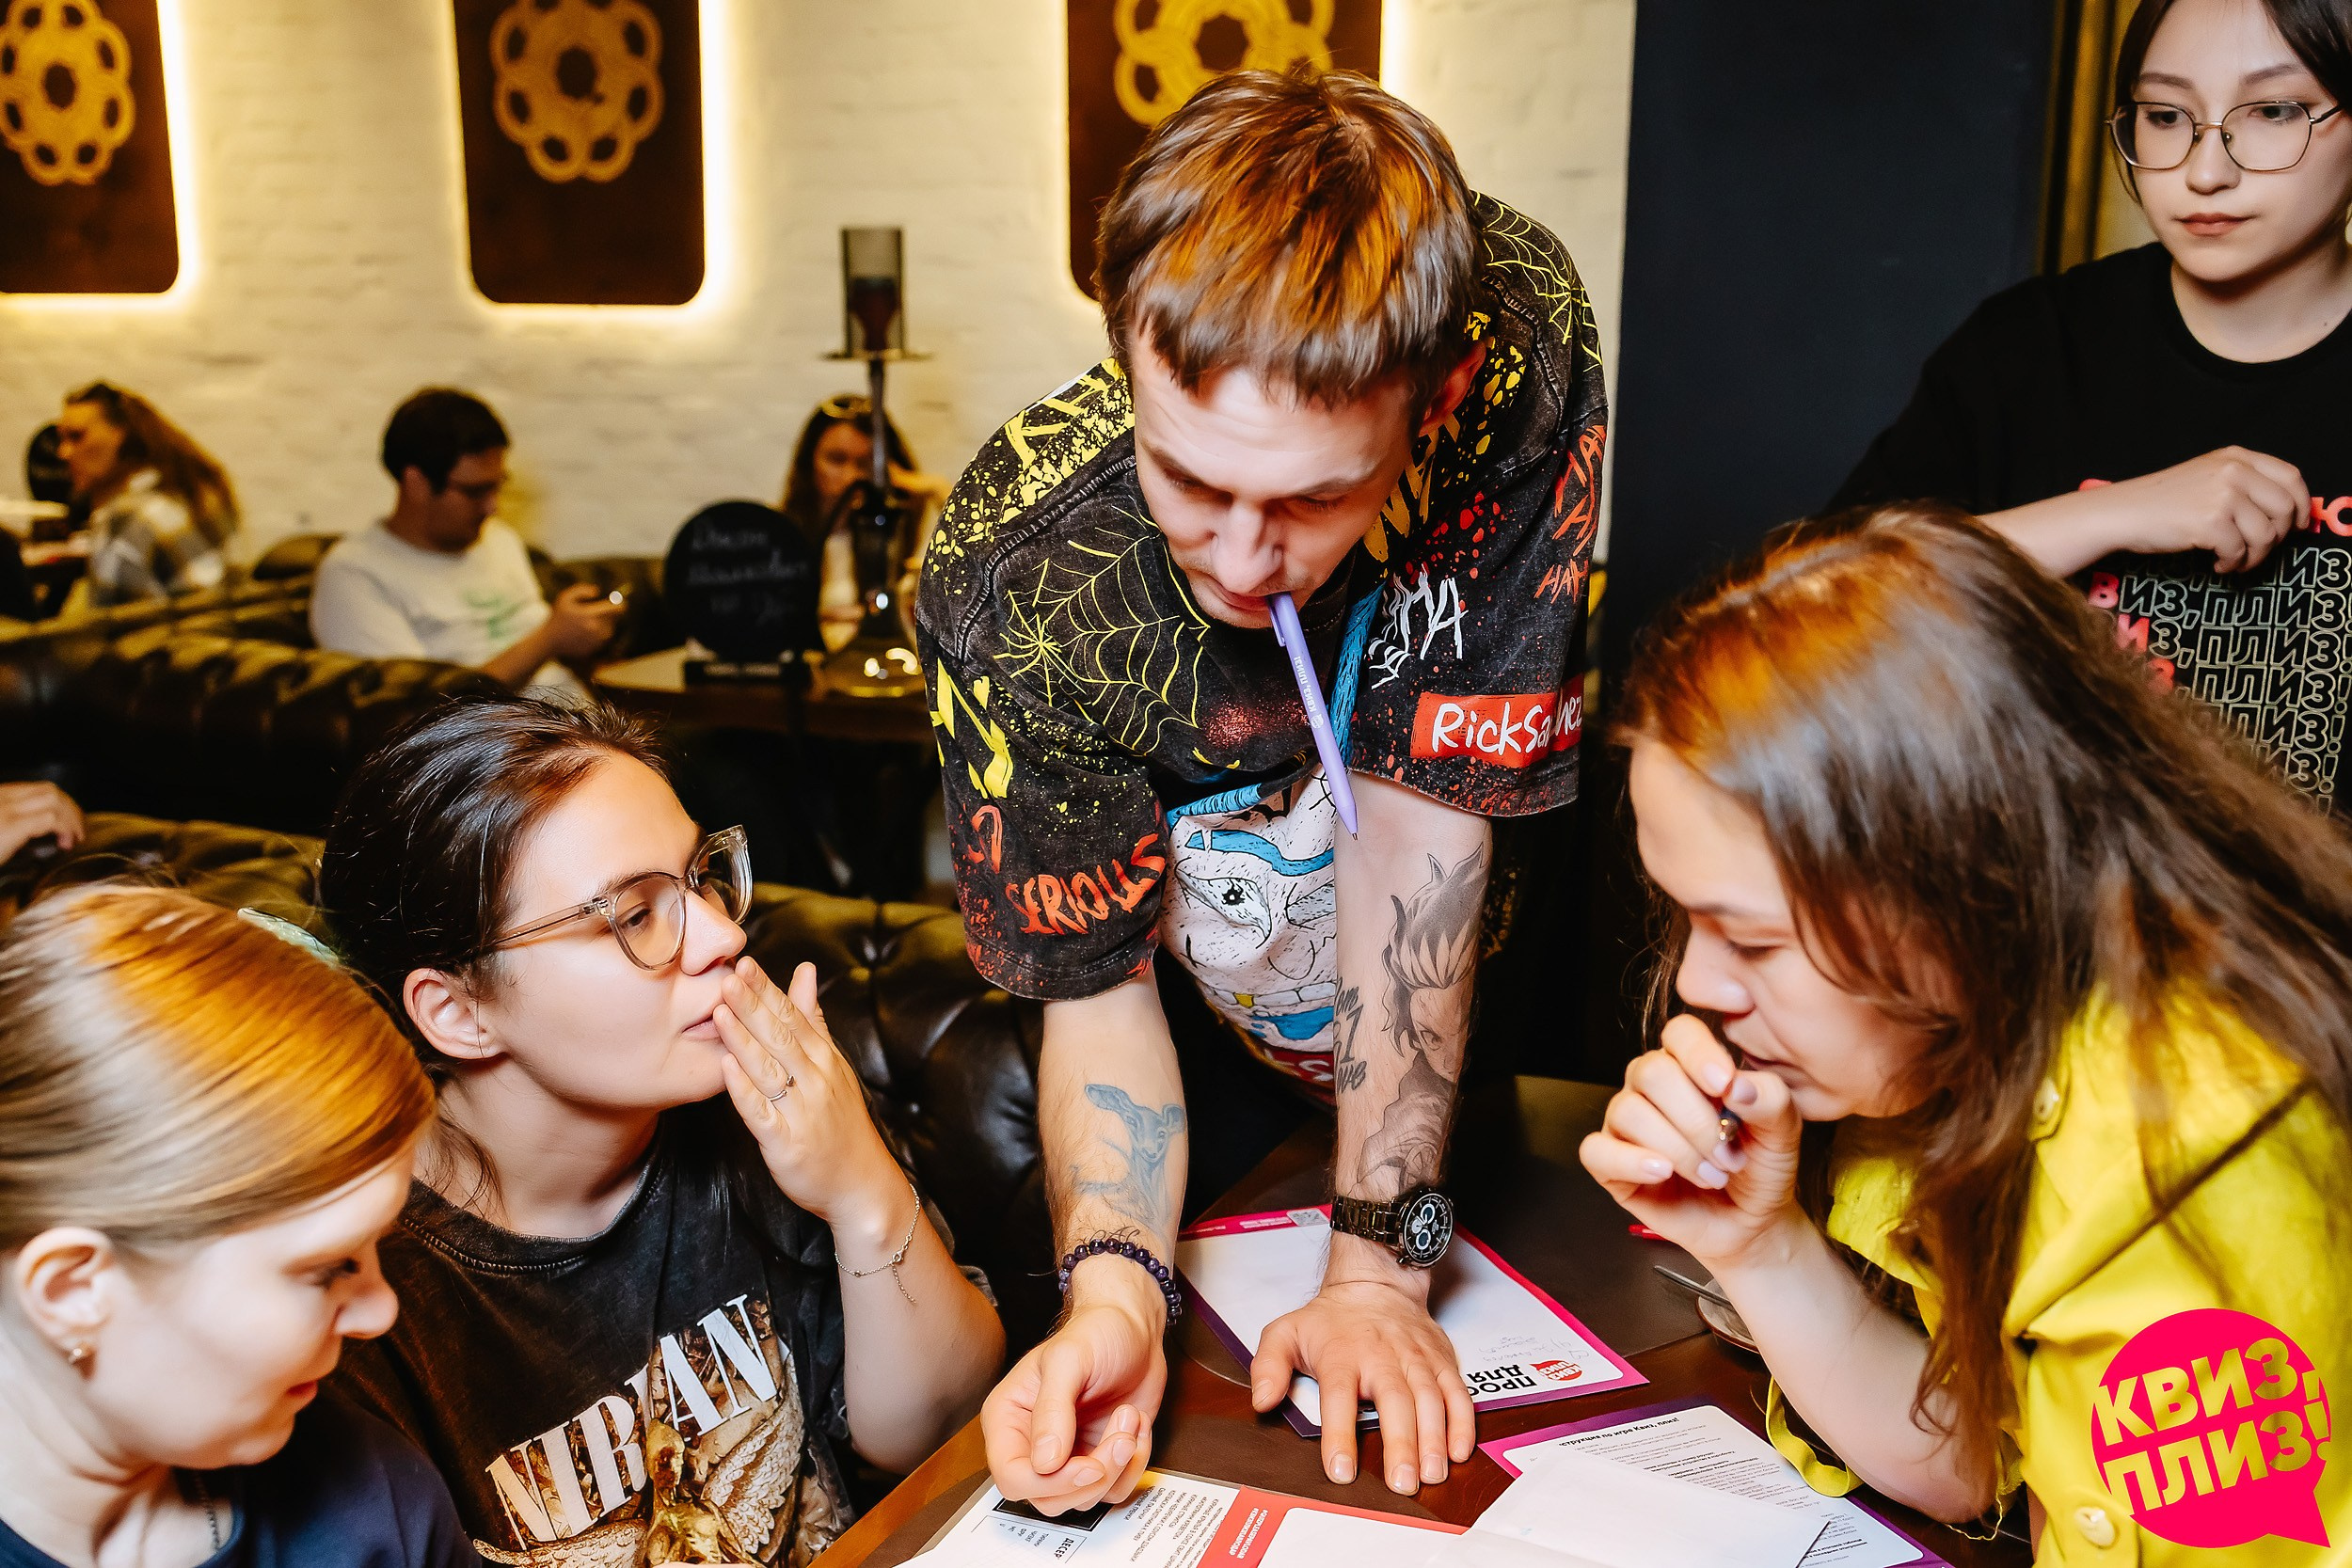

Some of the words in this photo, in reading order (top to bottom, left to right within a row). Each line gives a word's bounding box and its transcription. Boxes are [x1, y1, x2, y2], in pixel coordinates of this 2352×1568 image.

[1294, 656, 1309, 685] ПЛИЗ!
[1467, 1365, 1524, 1383] ДЛЯ
[1054, 1537, 1074, 1560] ДЕСЕР
